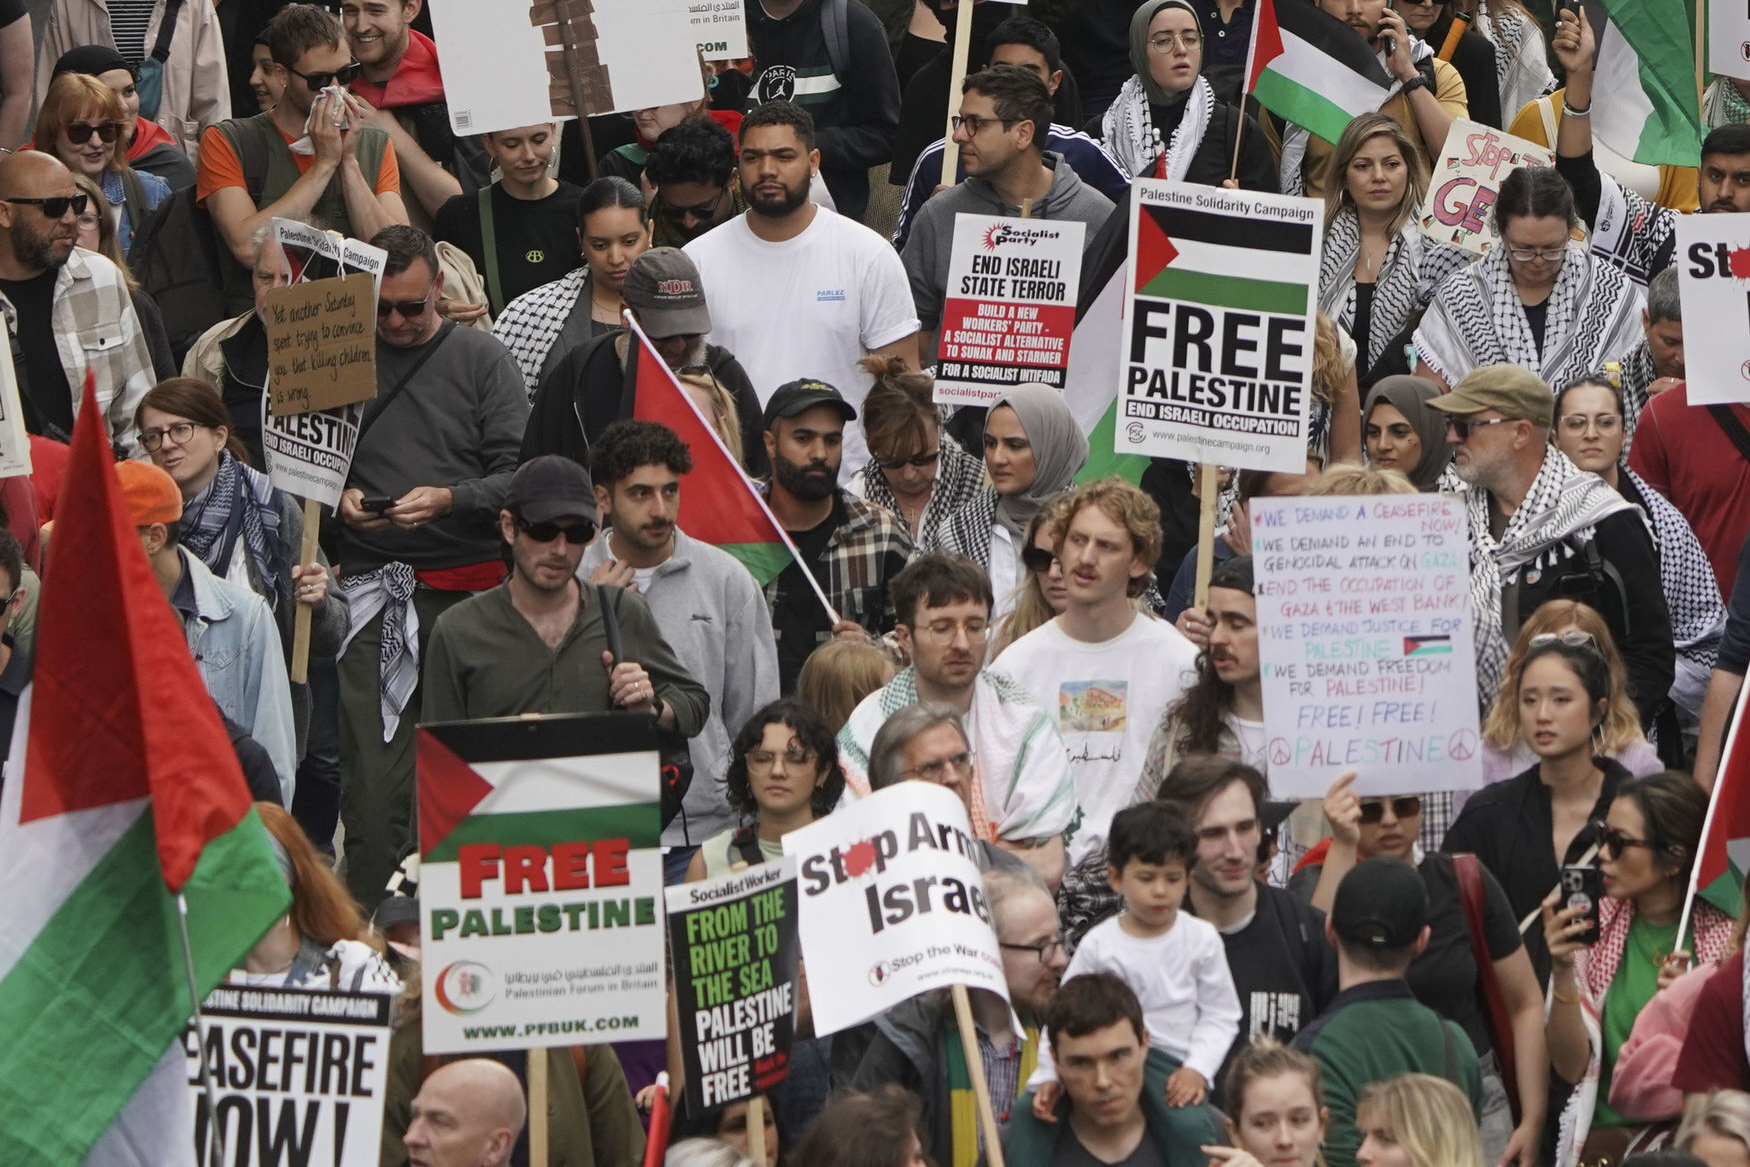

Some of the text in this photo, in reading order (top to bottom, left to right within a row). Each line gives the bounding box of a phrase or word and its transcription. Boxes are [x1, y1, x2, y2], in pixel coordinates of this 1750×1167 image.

[1461, 132, 1512, 180] STOP
[1139, 187, 1315, 221] Palestine Solidarity Campaign
[1001, 225, 1060, 239] Socialist
[971, 254, 1061, 280] END ISRAELI
[960, 275, 1066, 302] STATE TERROR
[962, 316, 1044, 335] WORKERS' PARTY
[1129, 298, 1306, 384] FREE
[946, 344, 1062, 365] TO SUNAK AND STARMER
[1126, 365, 1303, 417] PALESTINE
[1128, 401, 1299, 437] END ISRAELI OCCUPATION
[1152, 428, 1271, 455] www.palestinecampaign.org
[1266, 573, 1456, 597] END THE OCCUPATION OF
[1270, 617, 1463, 641] WE DEMAND JUSTICE FOR
[1304, 637, 1393, 661] PALESTINE
[1273, 657, 1452, 679] WE DEMAND FREEDOM
[1289, 675, 1425, 698] FOR PALESTINE!
[1297, 700, 1437, 731] FREE! FREE!
[1295, 735, 1446, 768] PALESTINE
[457, 838, 631, 900] FREE
[430, 896, 657, 941] PALESTINE
[685, 887, 786, 947] FROM THE
[687, 923, 778, 979] RIVER TO
[690, 958, 774, 1010] THE SEA
[241, 990, 312, 1015] SOLIDARITY
[311, 994, 379, 1020] CAMPAIGN
[695, 980, 793, 1043] PALESTINE
[463, 1015, 640, 1041] WWW.PFBUK.COM
[697, 1022, 776, 1075] WILL BE
[701, 1064, 752, 1109] FREE
